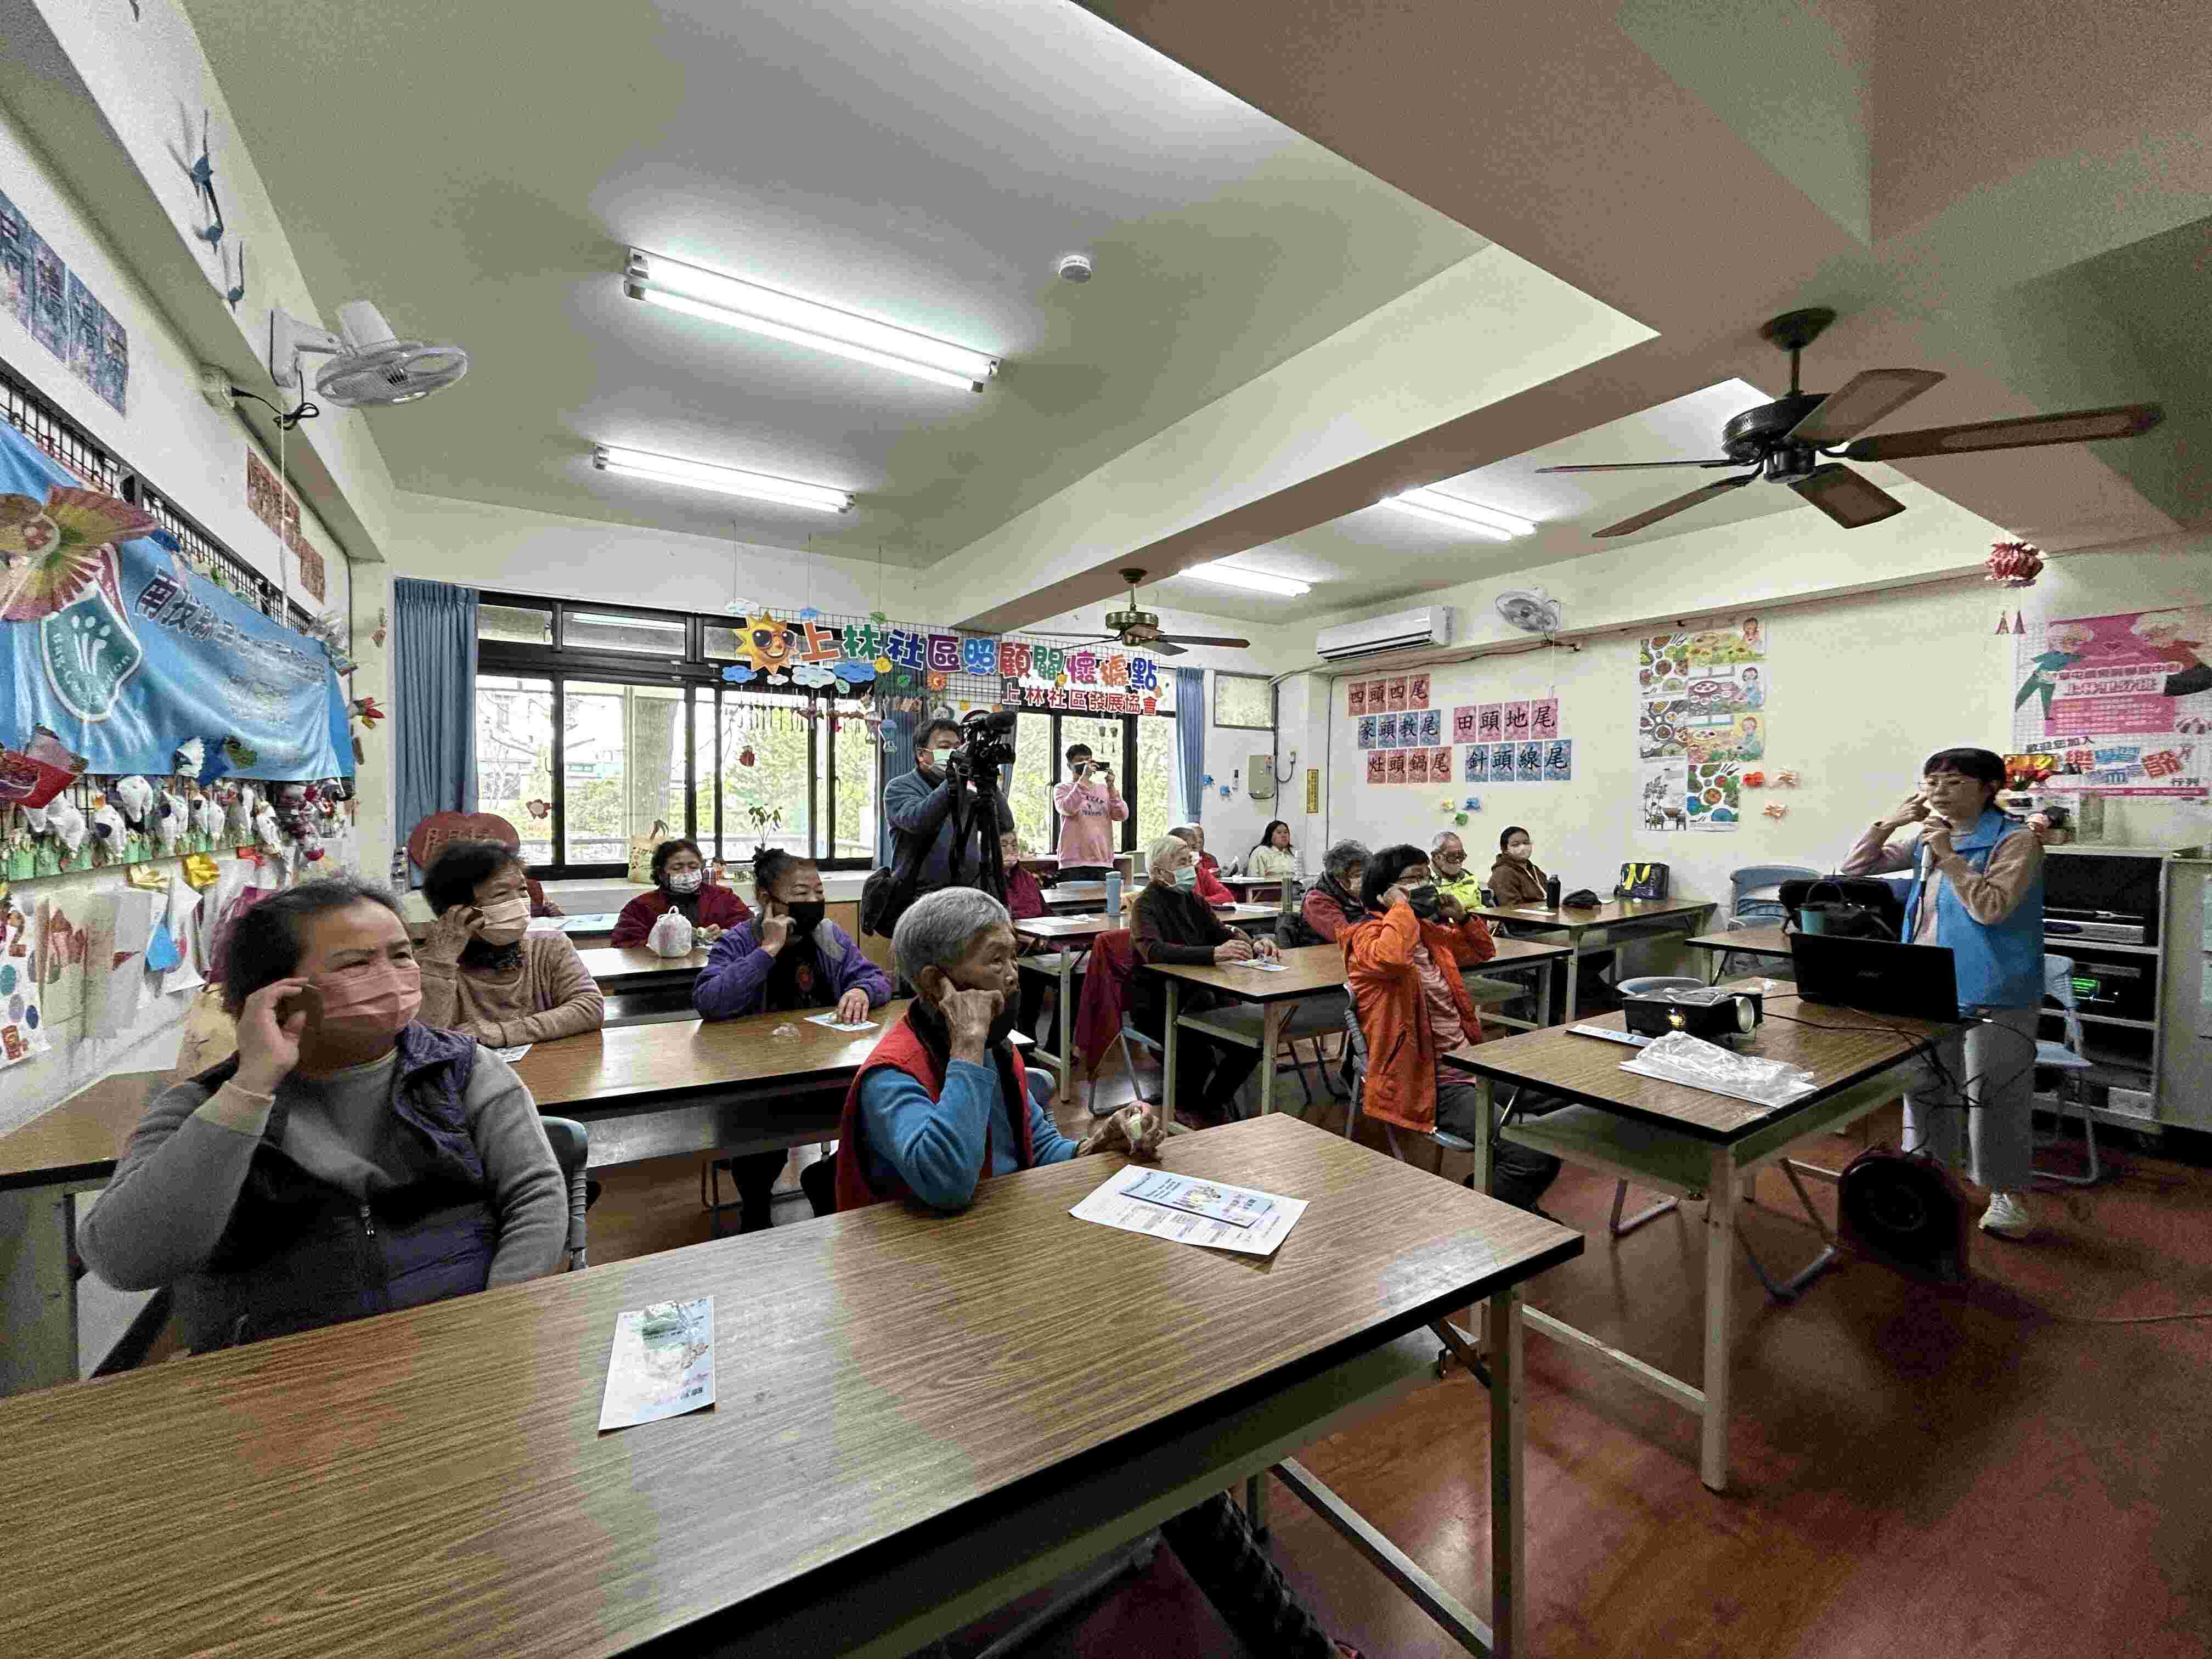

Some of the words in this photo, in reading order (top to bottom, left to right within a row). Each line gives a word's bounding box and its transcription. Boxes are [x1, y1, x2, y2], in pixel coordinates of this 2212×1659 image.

[800, 621, 1159, 692] 上林社區照顧關懷據點
[1001, 681, 1159, 716] 上林社區發展協會
[1351, 680, 1428, 704] 四頭四尾
[1359, 715, 1438, 741] 家頭教尾
[1457, 705, 1556, 731] 田頭地尾
[1368, 752, 1450, 774] 灶頭鍋尾
[1468, 746, 1568, 772] 針頭線尾
